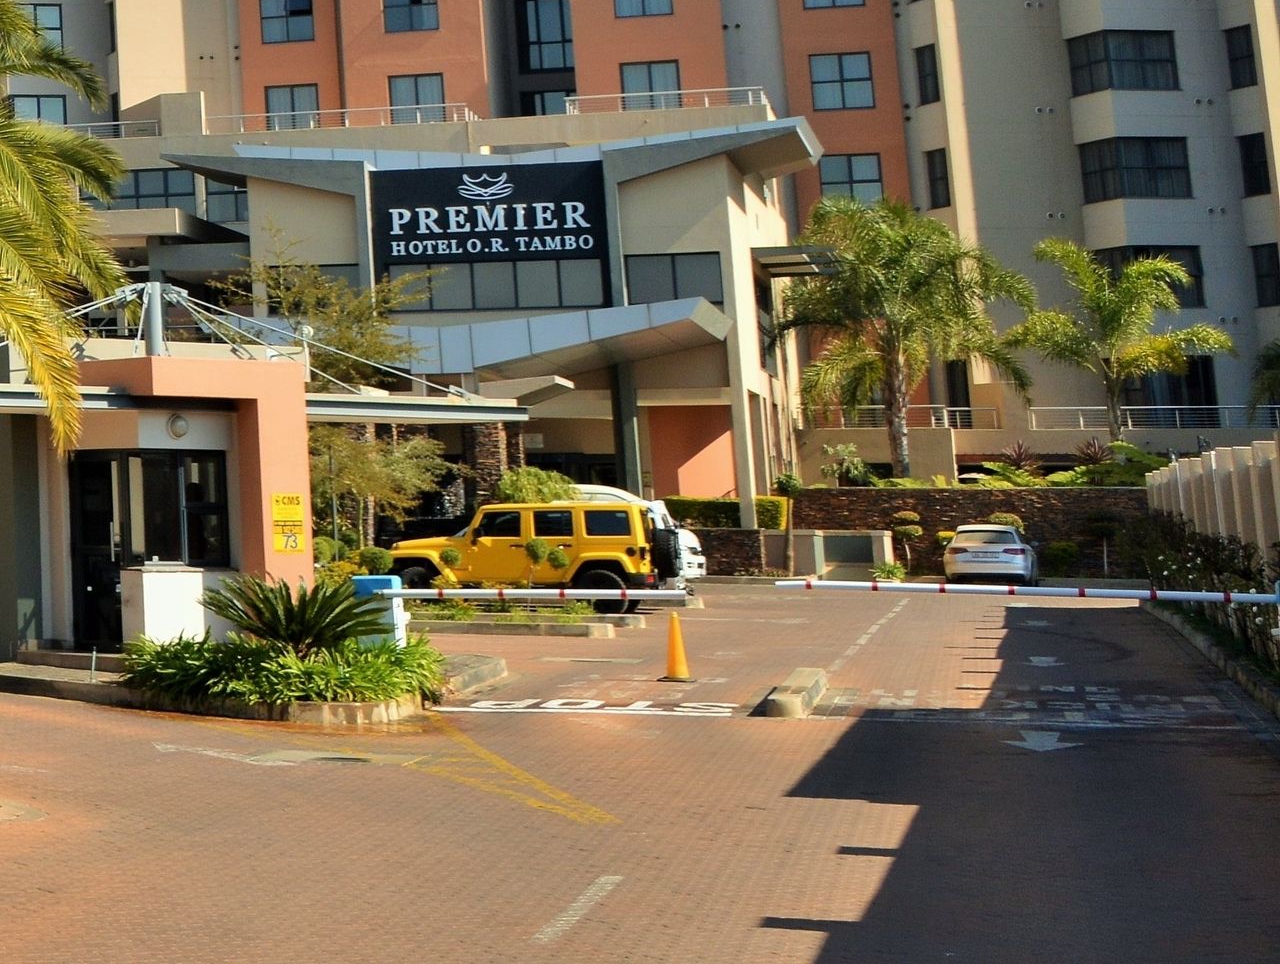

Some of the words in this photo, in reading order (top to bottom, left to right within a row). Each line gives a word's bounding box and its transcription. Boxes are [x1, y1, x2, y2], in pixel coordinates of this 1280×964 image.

[388, 201, 591, 235] PREMIER
[391, 238, 463, 256] HOTEL
[466, 237, 510, 254] O.R.
[514, 234, 594, 252] TAMBO
[470, 698, 740, 713] STOP
